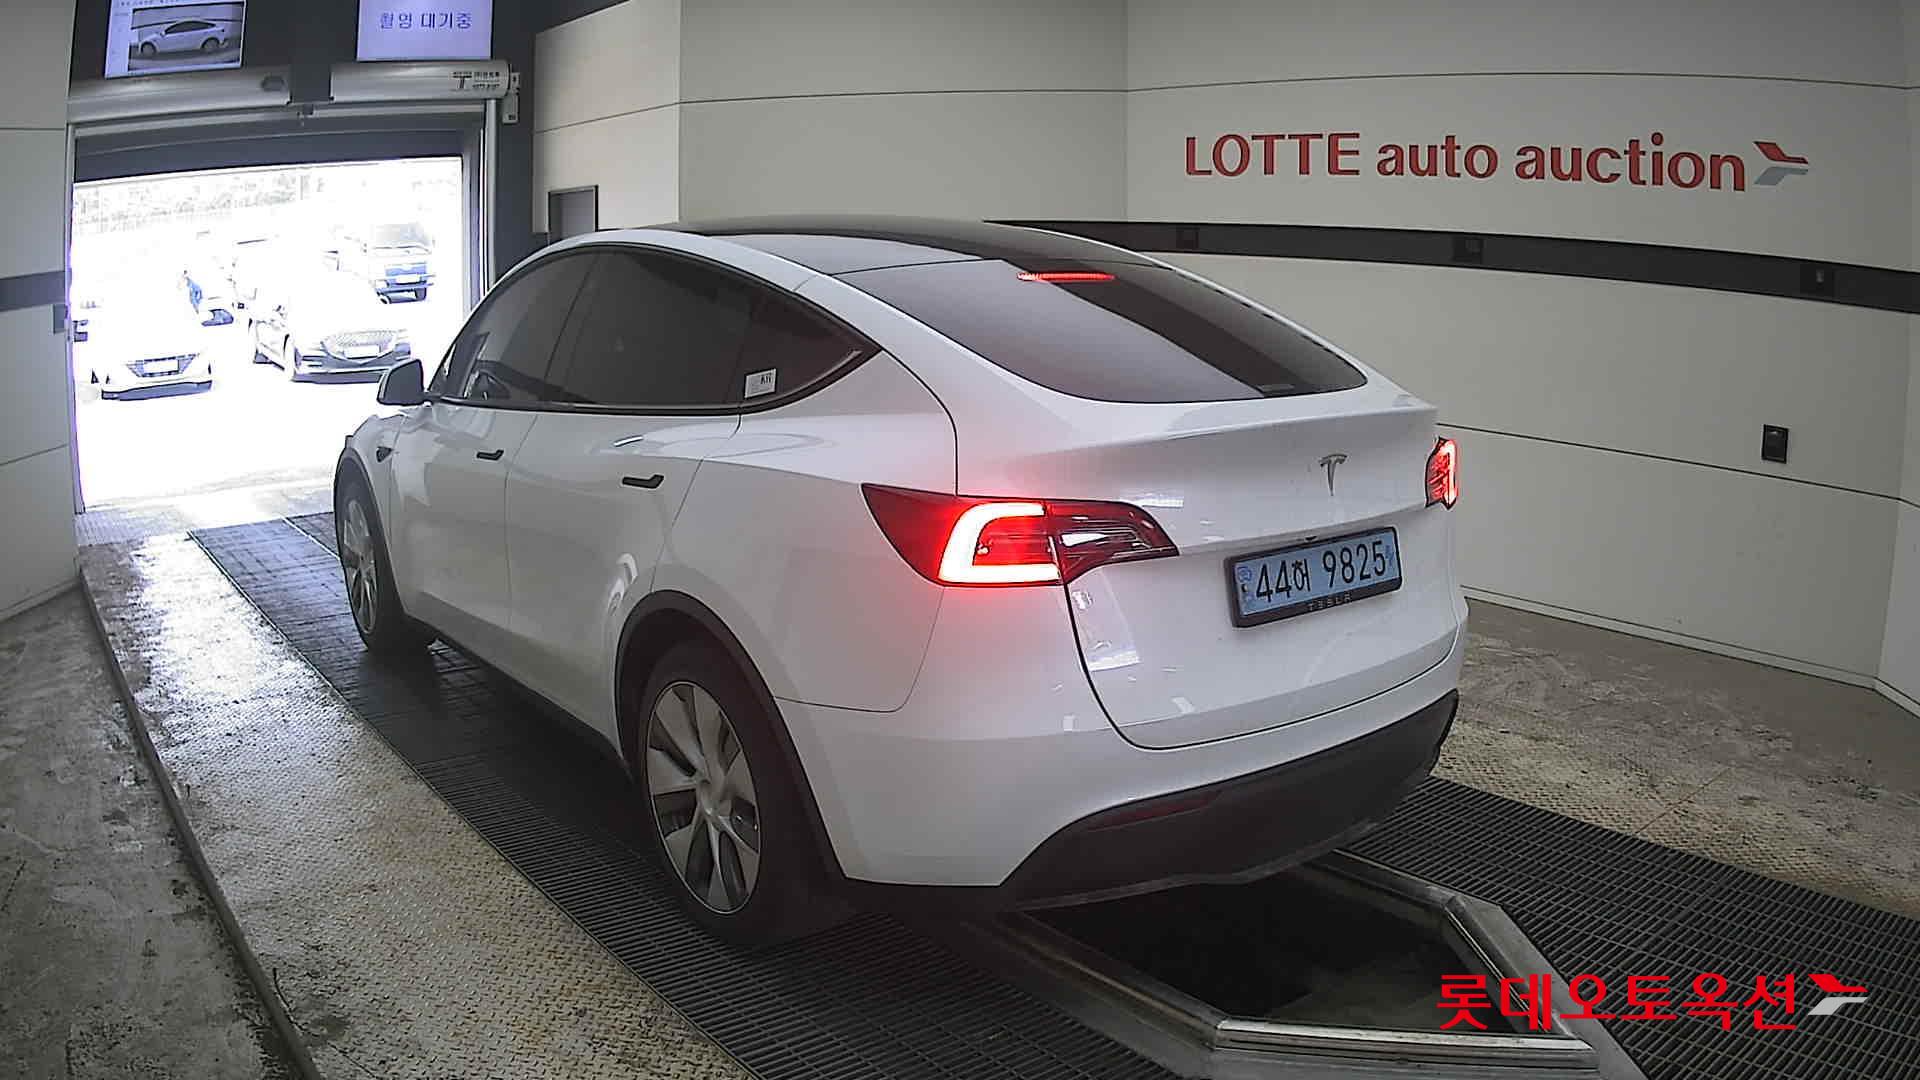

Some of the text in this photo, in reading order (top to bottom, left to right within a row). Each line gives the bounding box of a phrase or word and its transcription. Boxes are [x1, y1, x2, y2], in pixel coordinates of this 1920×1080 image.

[420, 12, 472, 30] 대기중
[1185, 131, 1746, 192] LOTTE auto auction
[1256, 540, 1387, 603] 44허 9825
